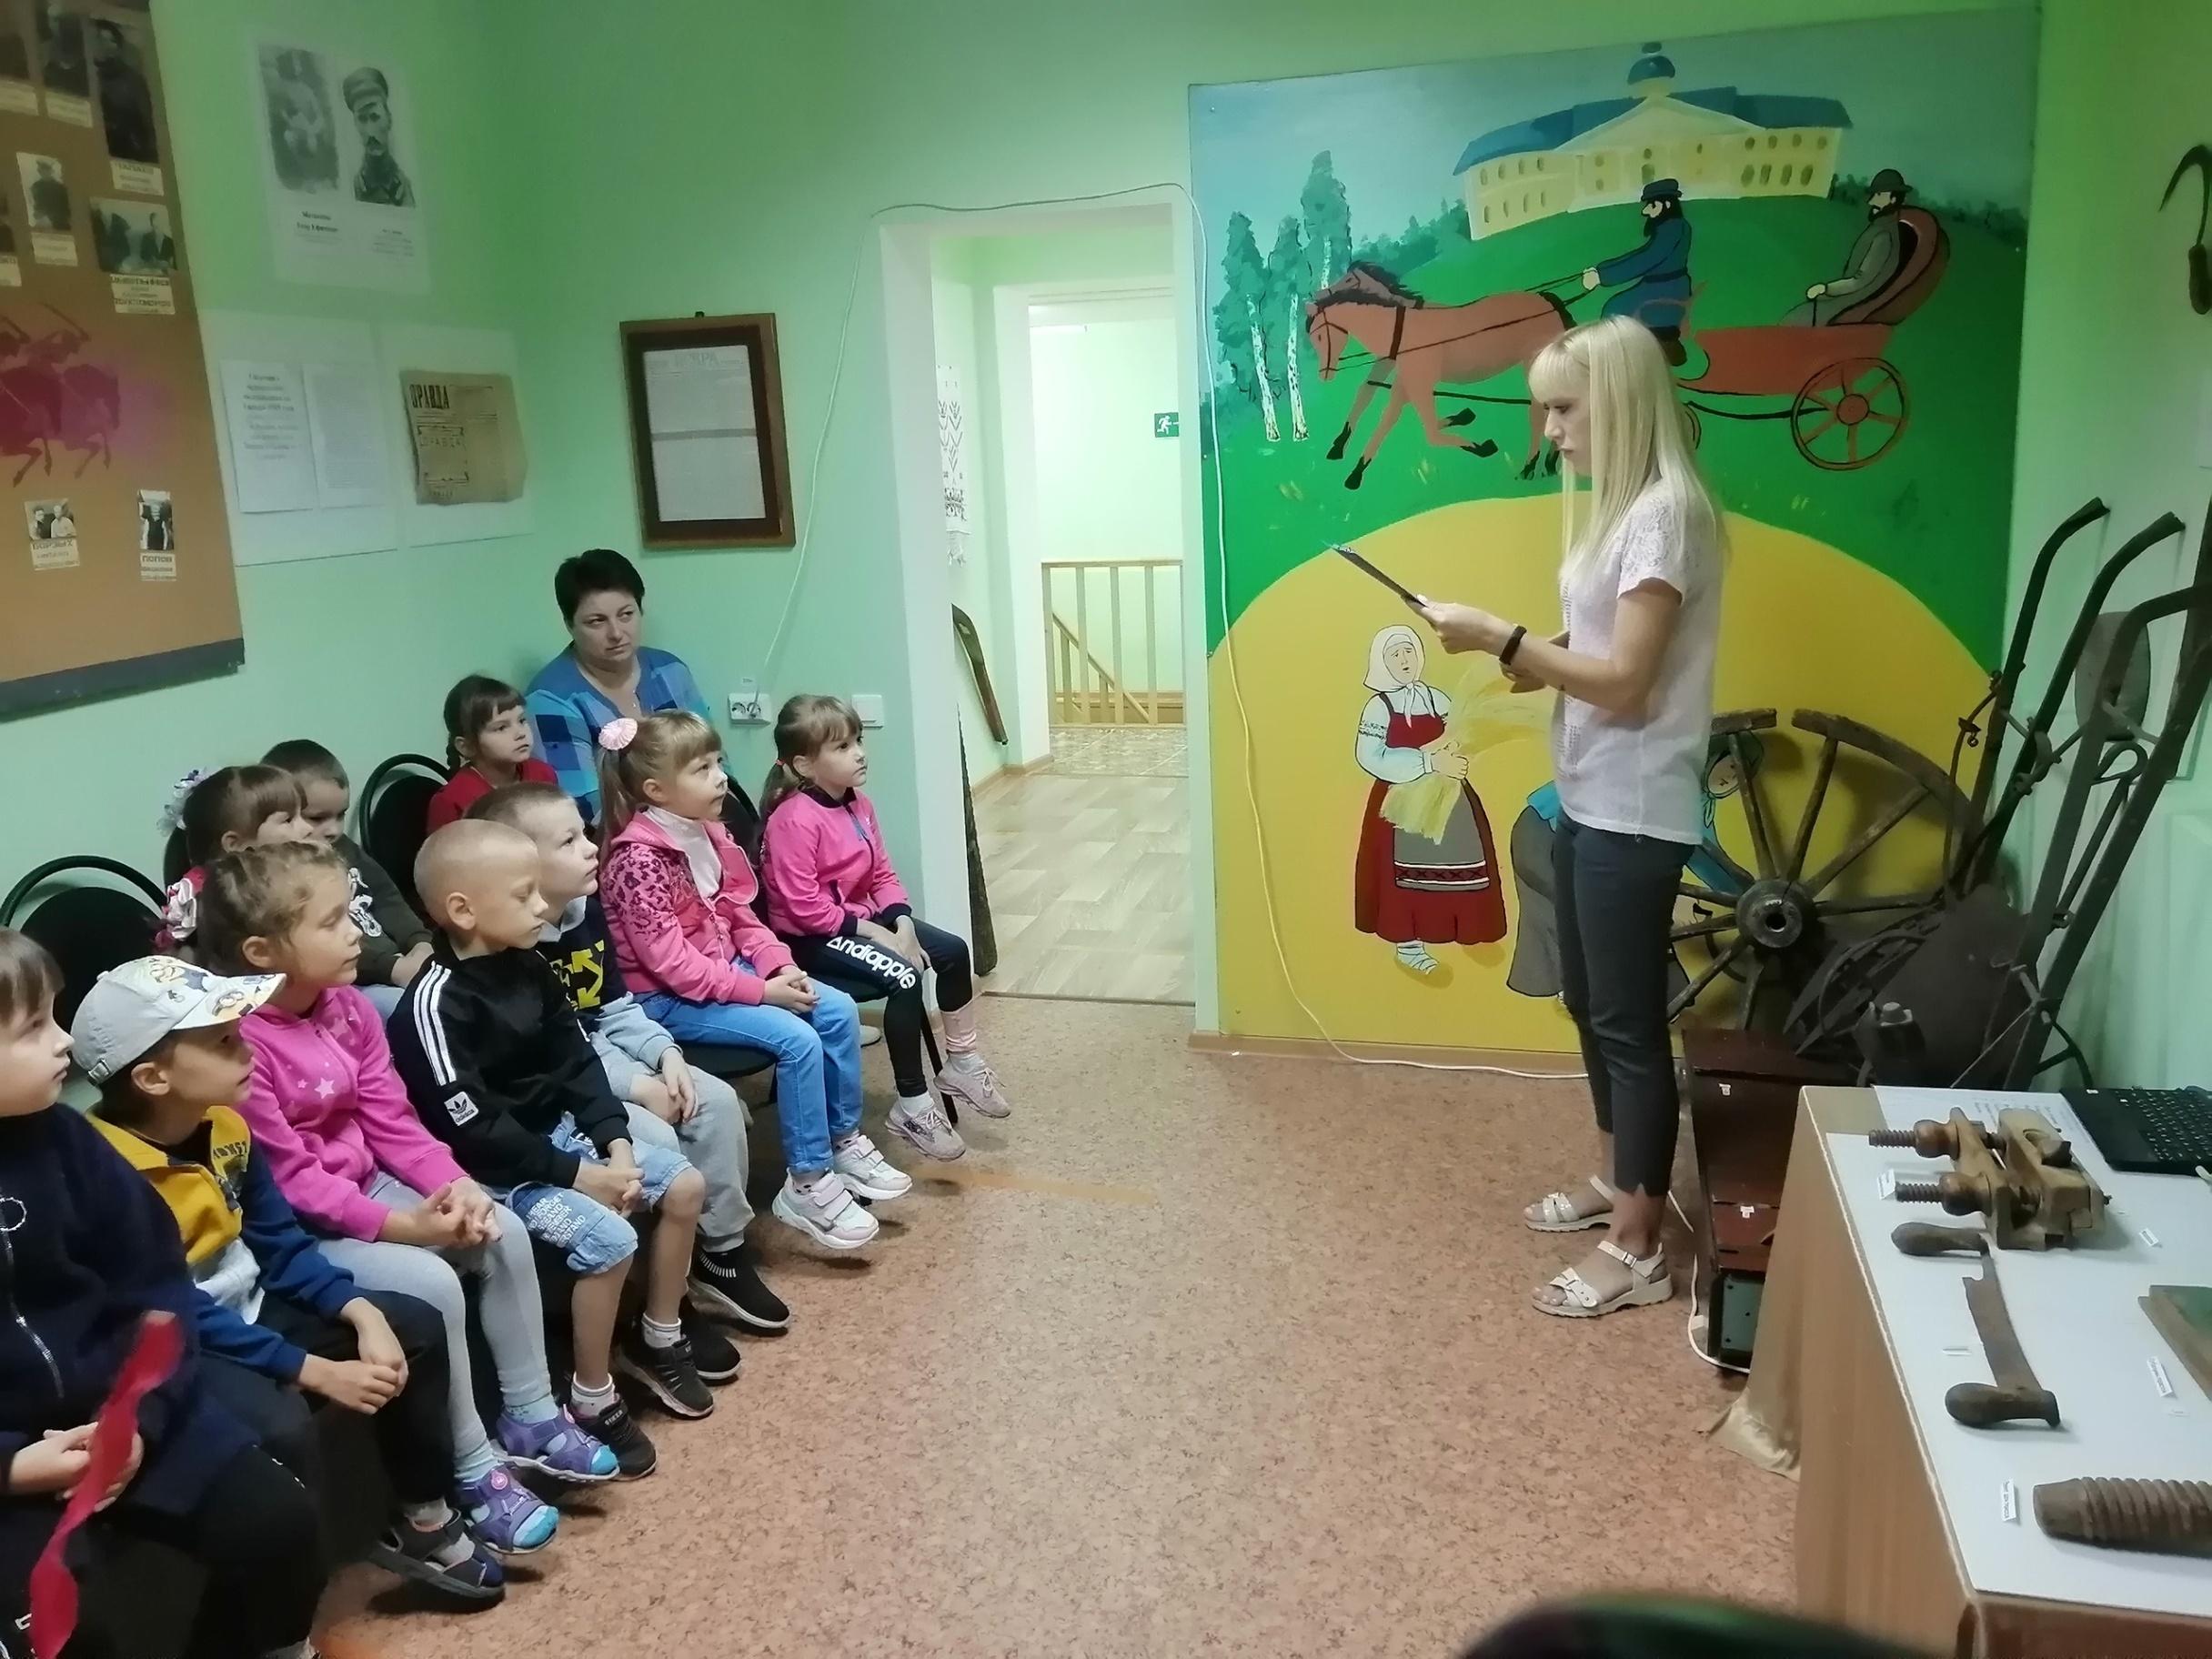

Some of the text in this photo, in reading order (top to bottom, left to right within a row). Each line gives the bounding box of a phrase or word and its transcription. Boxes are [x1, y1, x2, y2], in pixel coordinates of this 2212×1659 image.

[528, 1198, 548, 1217] HEAR
[536, 1192, 564, 1219] FORGET
[547, 1202, 564, 1219] AND
